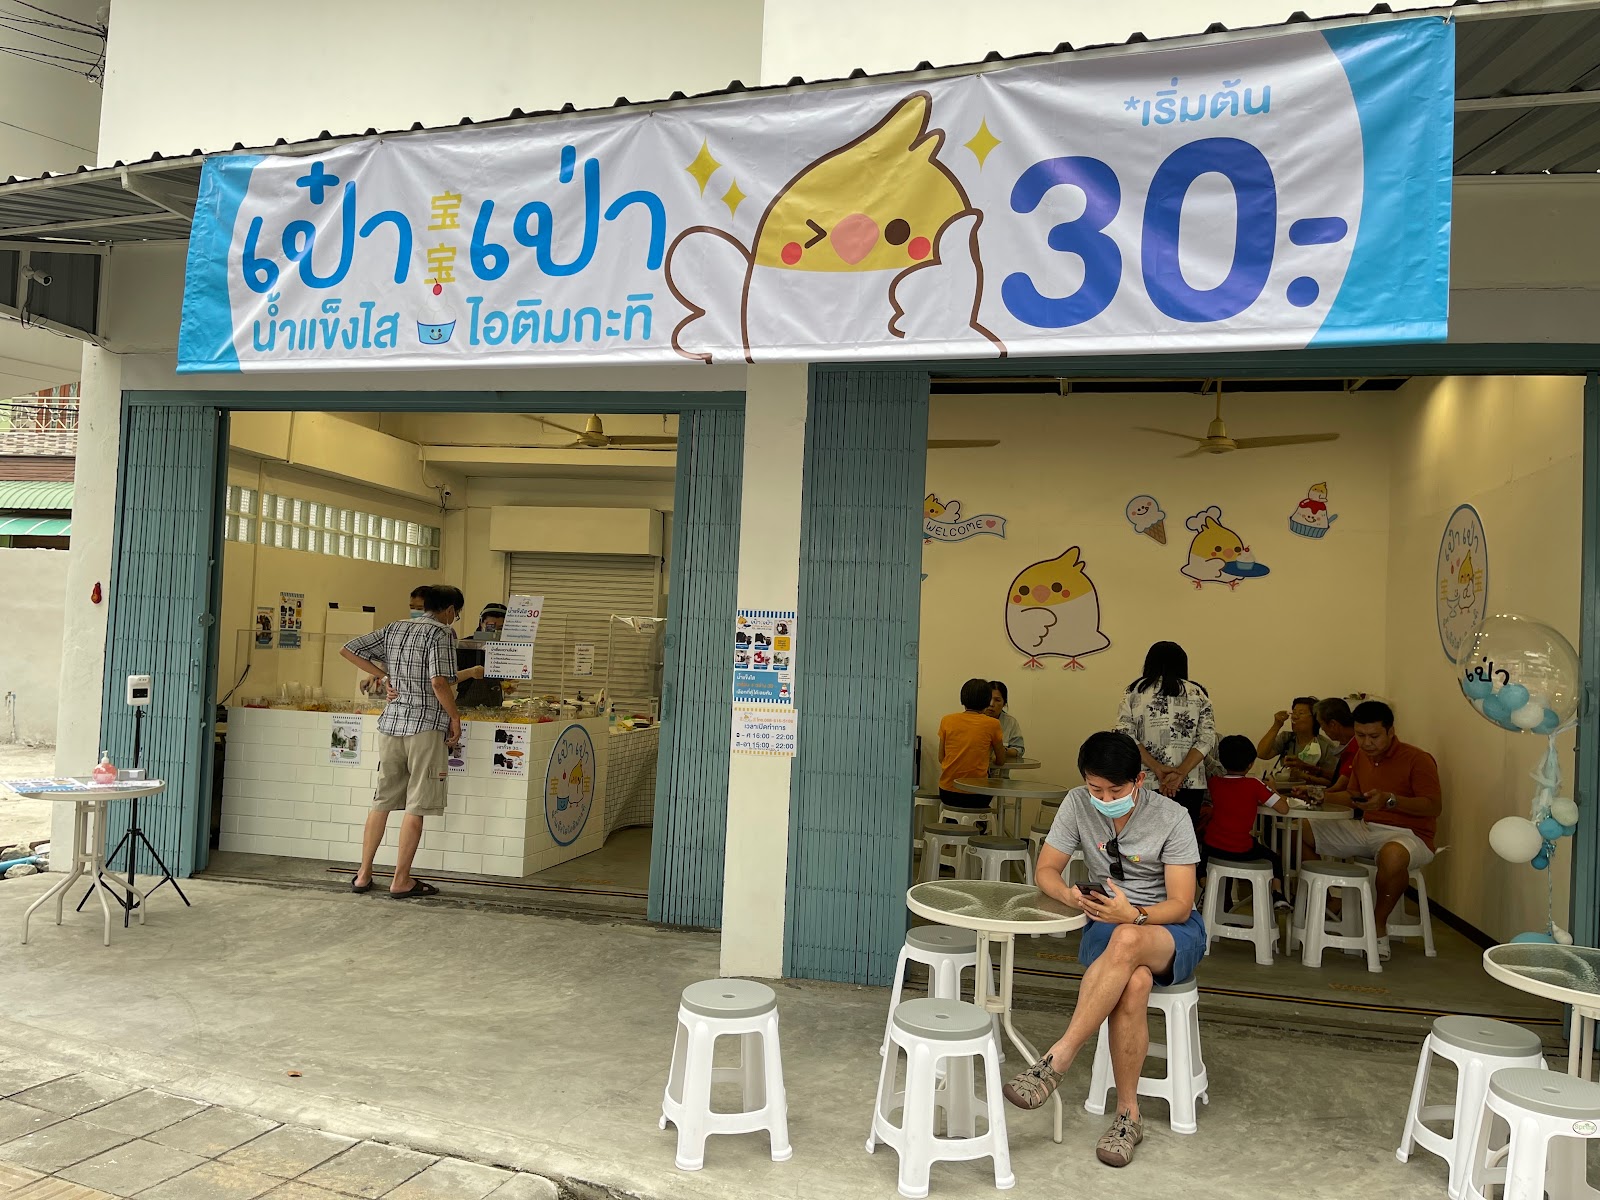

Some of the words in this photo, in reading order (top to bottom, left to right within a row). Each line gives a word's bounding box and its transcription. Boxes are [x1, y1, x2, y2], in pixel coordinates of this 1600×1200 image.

[241, 161, 413, 293] เป๋า
[469, 145, 667, 281] เป่า
[252, 292, 401, 353] น้ำแข็งไส
[465, 292, 655, 347] ไอติมกะทิ
[926, 519, 983, 537] WELCOME
[526, 609, 540, 618] 30
